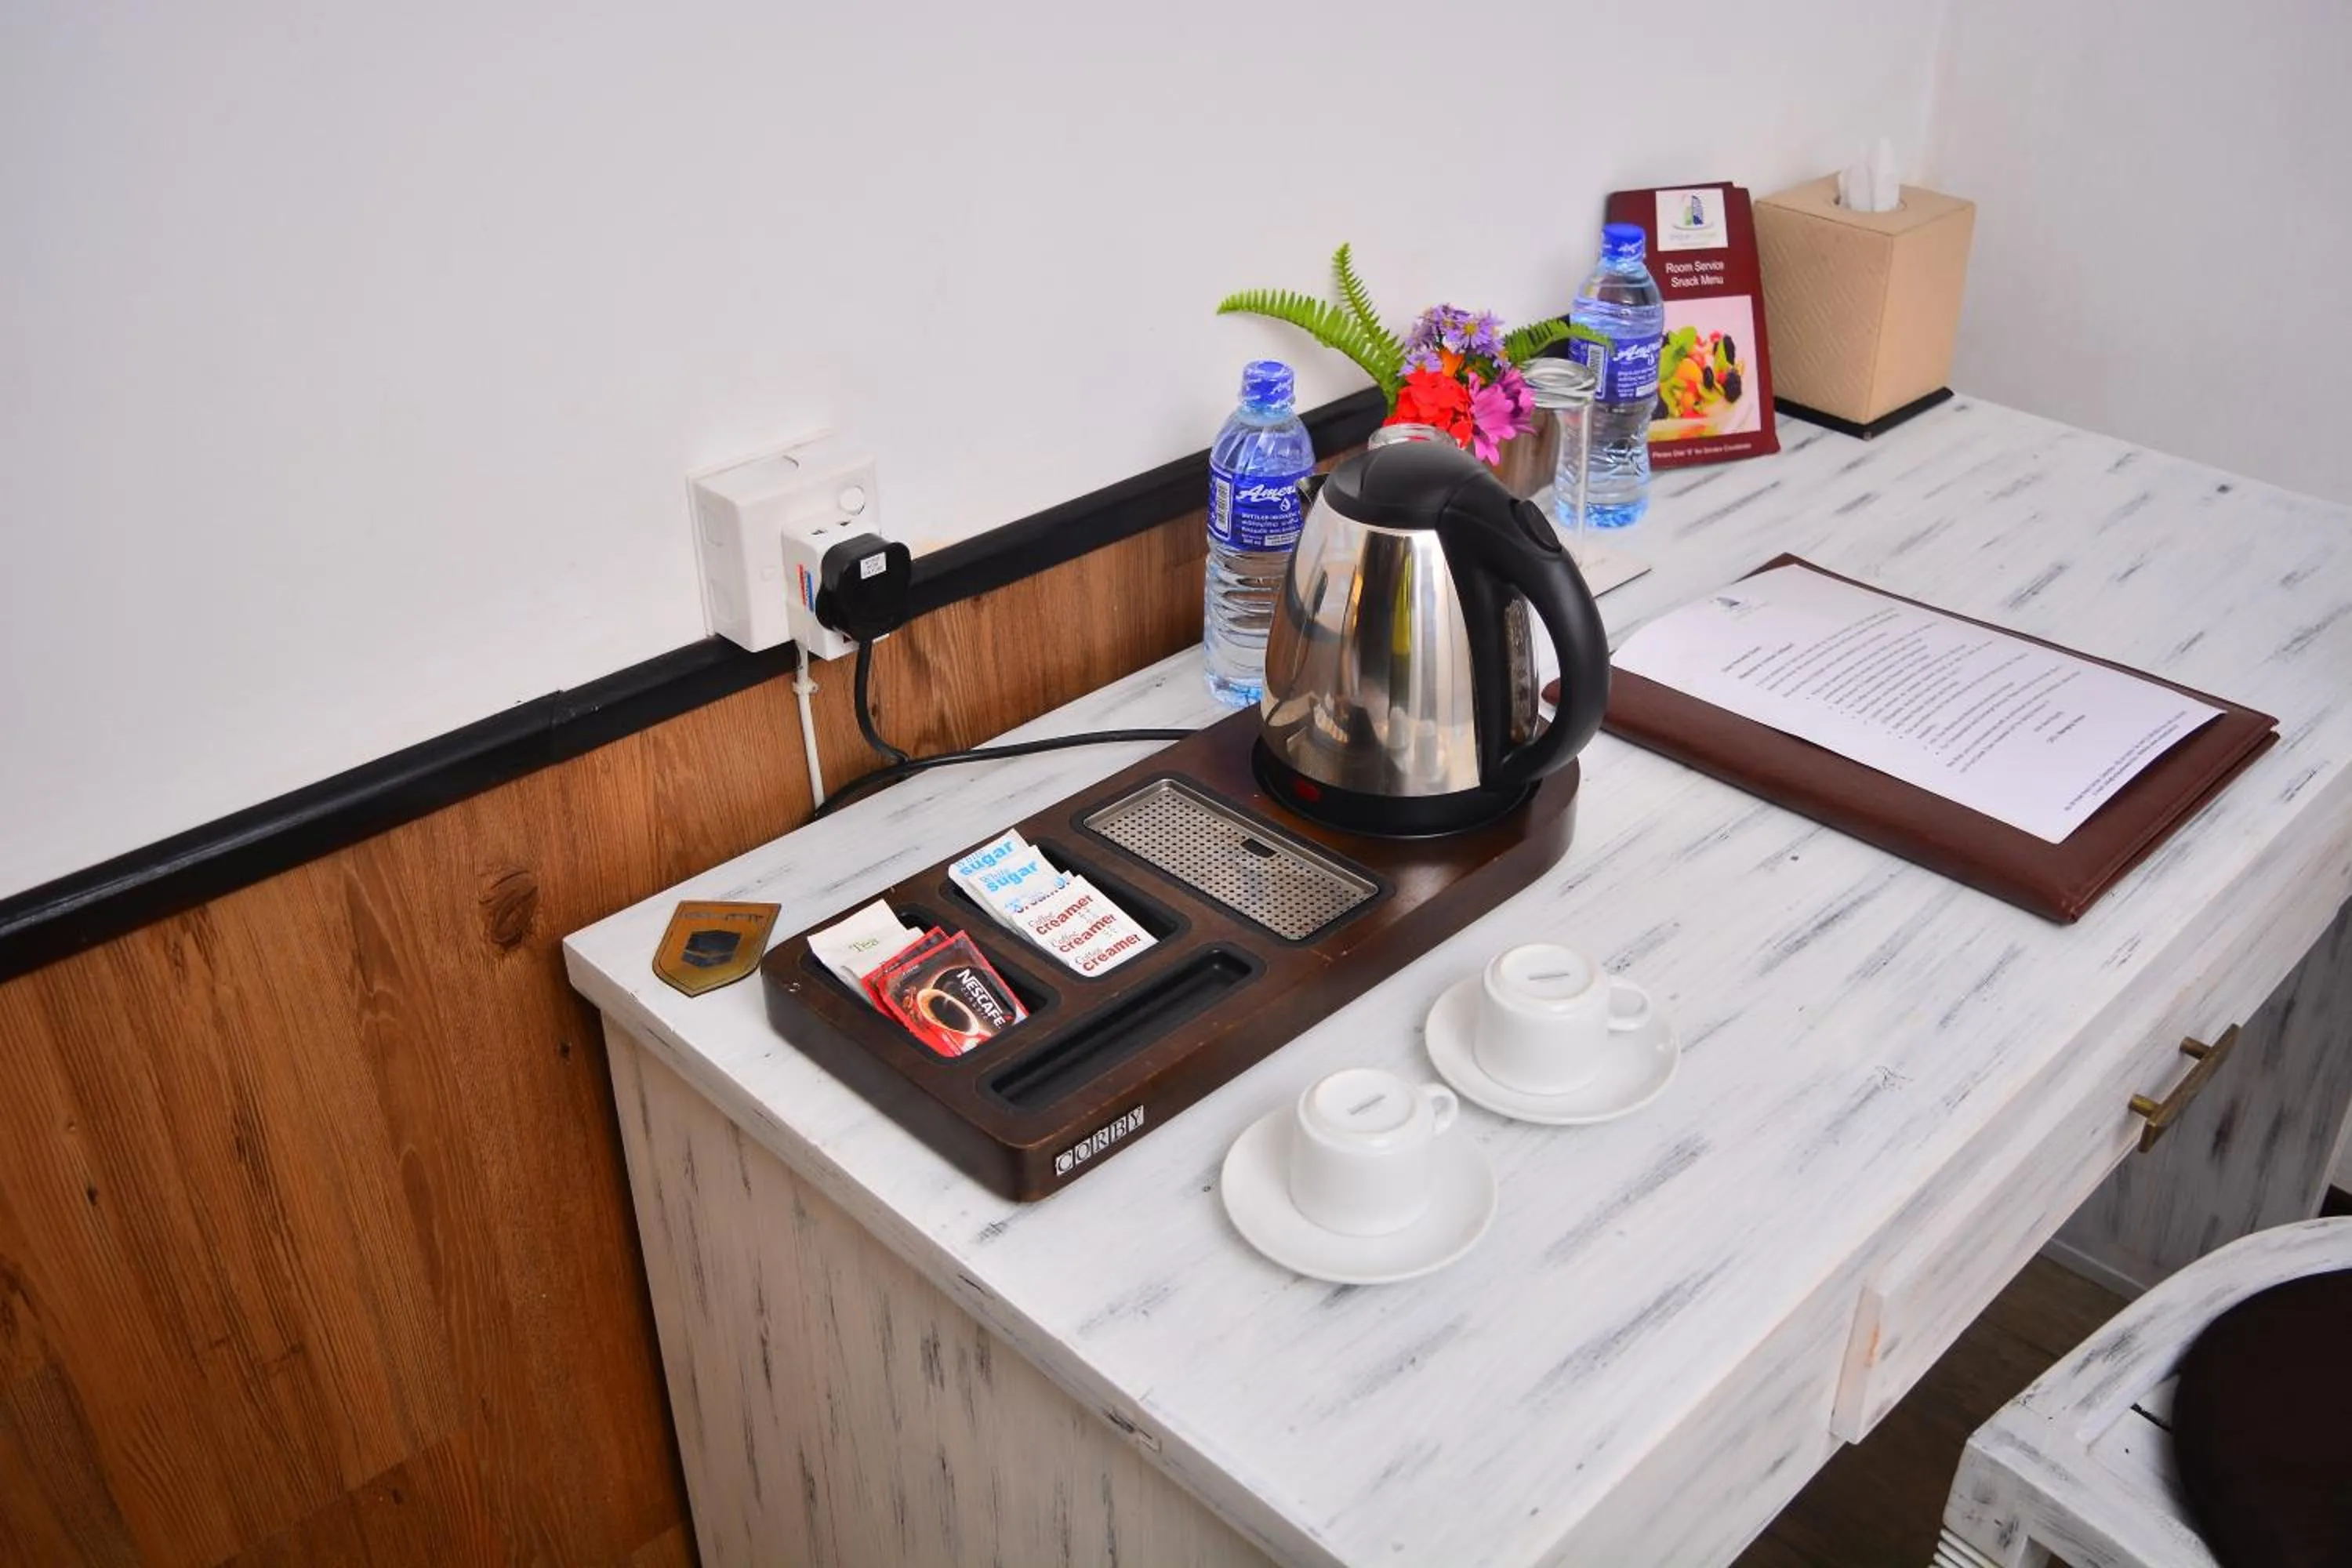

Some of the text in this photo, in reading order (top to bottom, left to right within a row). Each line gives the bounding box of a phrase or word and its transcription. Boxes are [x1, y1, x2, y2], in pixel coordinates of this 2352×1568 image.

[1666, 260, 1724, 274] Room Service
[1671, 274, 1724, 289] Snack Menu
[960, 840, 1013, 876] sugar
[987, 861, 1039, 892] sugar
[1036, 894, 1094, 935] creamer
[1059, 913, 1116, 953] creamer
[1083, 933, 1142, 972] creamer
[1055, 1105, 1145, 1176] CORBY
